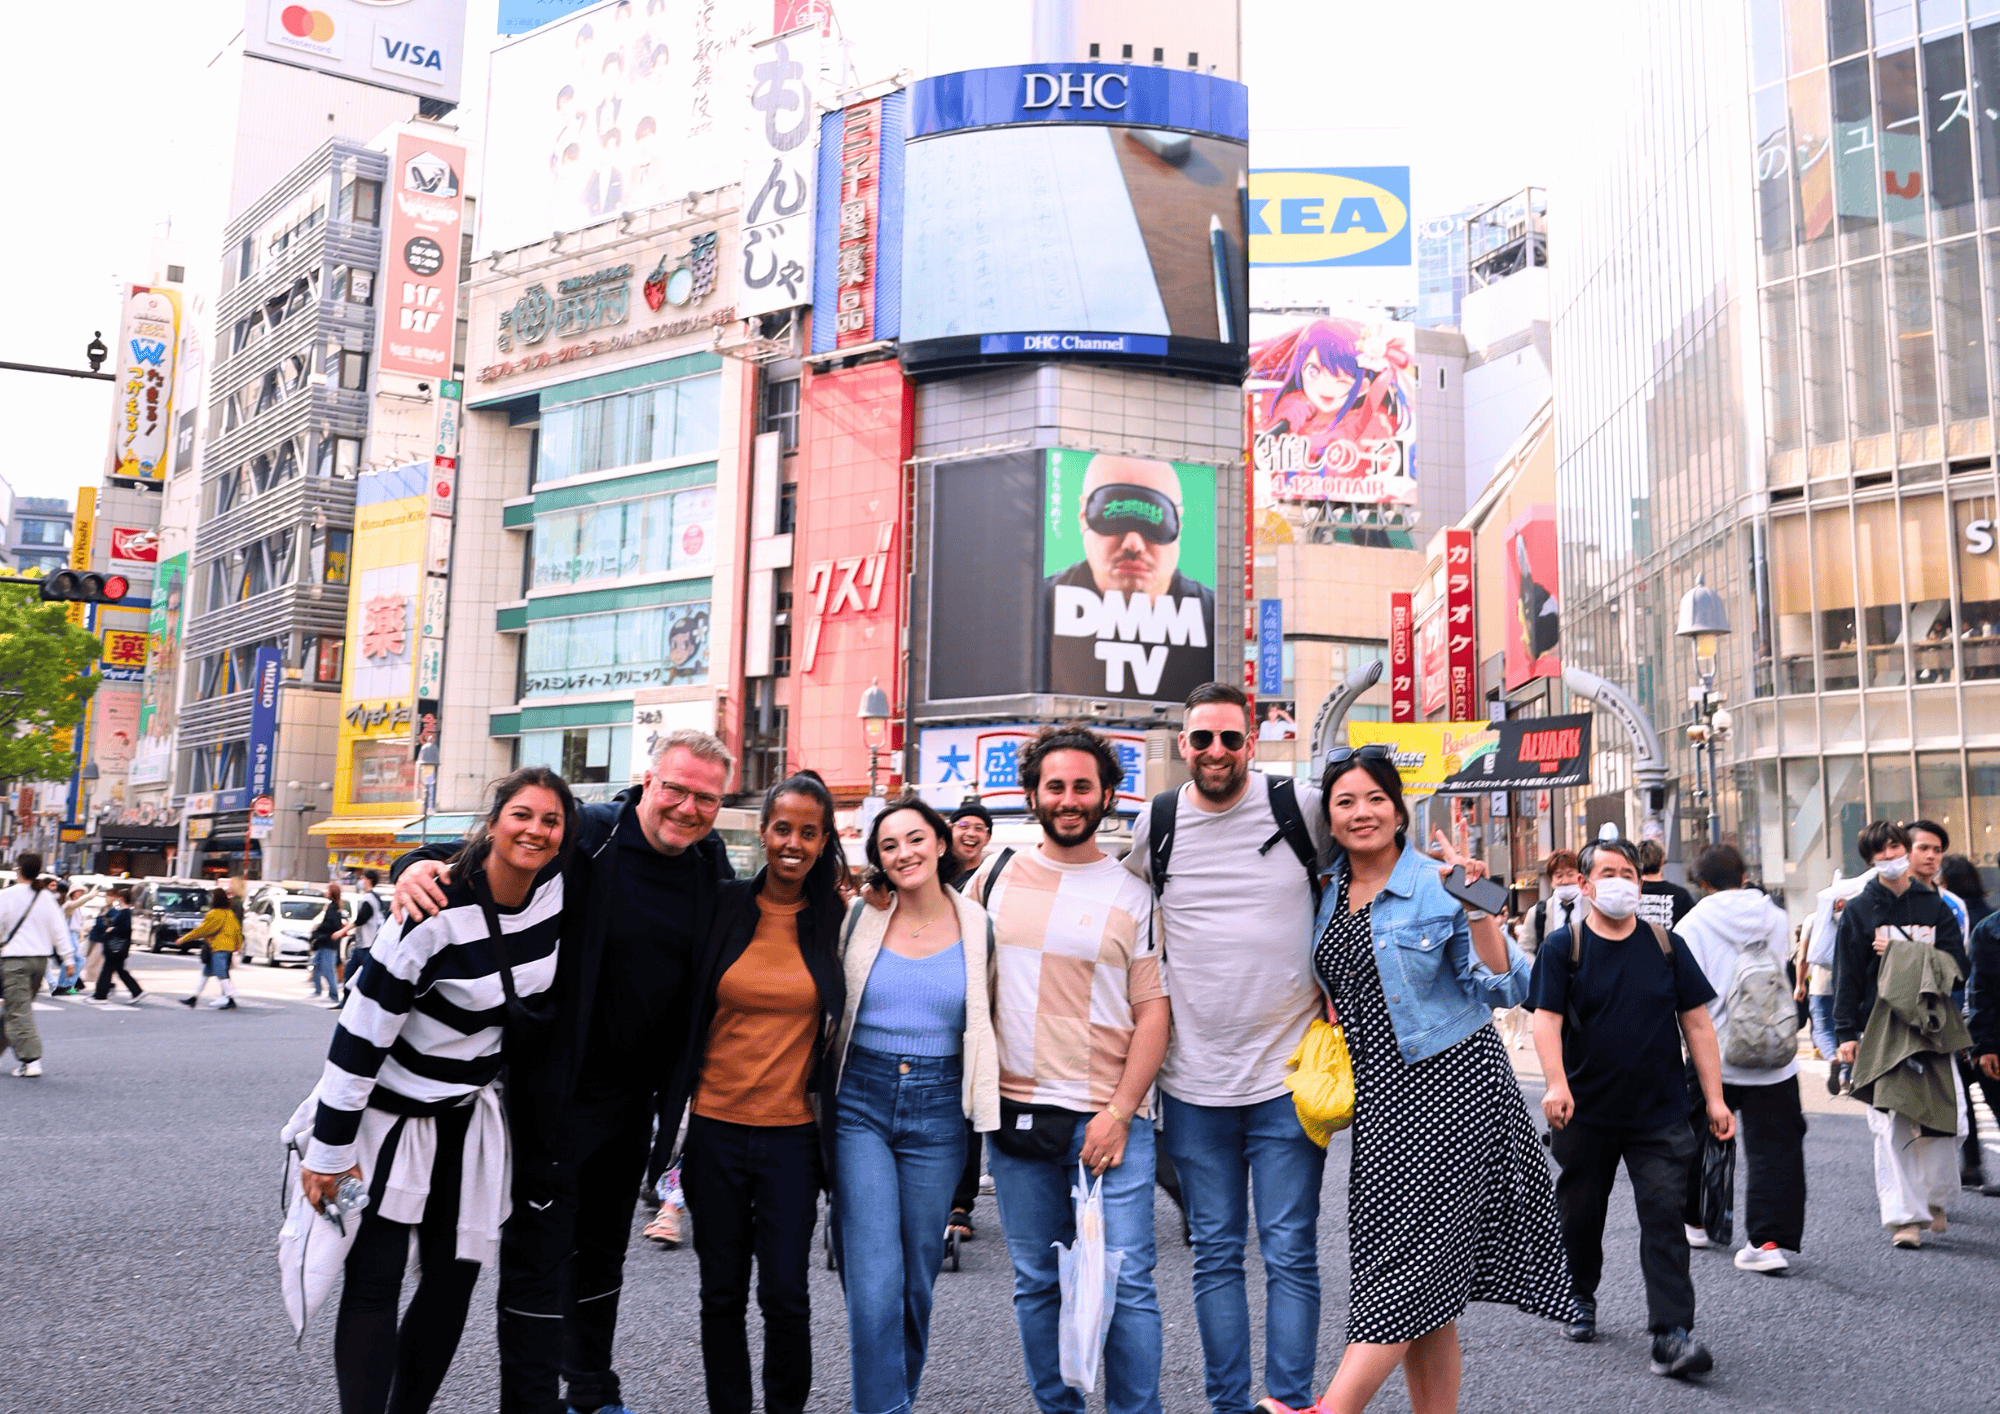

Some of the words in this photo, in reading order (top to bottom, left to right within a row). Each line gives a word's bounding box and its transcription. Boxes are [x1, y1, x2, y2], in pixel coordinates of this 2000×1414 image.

[379, 36, 442, 71] VISA
[1022, 73, 1129, 109] DHC
[743, 40, 812, 301] もんじゃ
[837, 107, 872, 334] 三千里薬品
[1249, 197, 1389, 235] KEA
[402, 281, 441, 307] B1F
[399, 306, 442, 333] B2F
[1023, 335, 1060, 350] DHC
[1061, 335, 1124, 351] Channel
[1966, 519, 2000, 554] S
[801, 520, 894, 673] クスリ
[1448, 544, 1472, 654] カラオケ
[1054, 584, 1207, 647] DMM
[1393, 607, 1407, 630] BIG
[111, 634, 146, 663] 薬
[1393, 631, 1407, 664] ECHO
[525, 668, 661, 692] ジャスミンレディースクリニック
[1094, 641, 1169, 696] TV
[1452, 666, 1467, 694] BIG
[1393, 674, 1411, 717] カラ
[1455, 695, 1468, 721] ECH
[345, 701, 413, 732] マツモトキヨ
